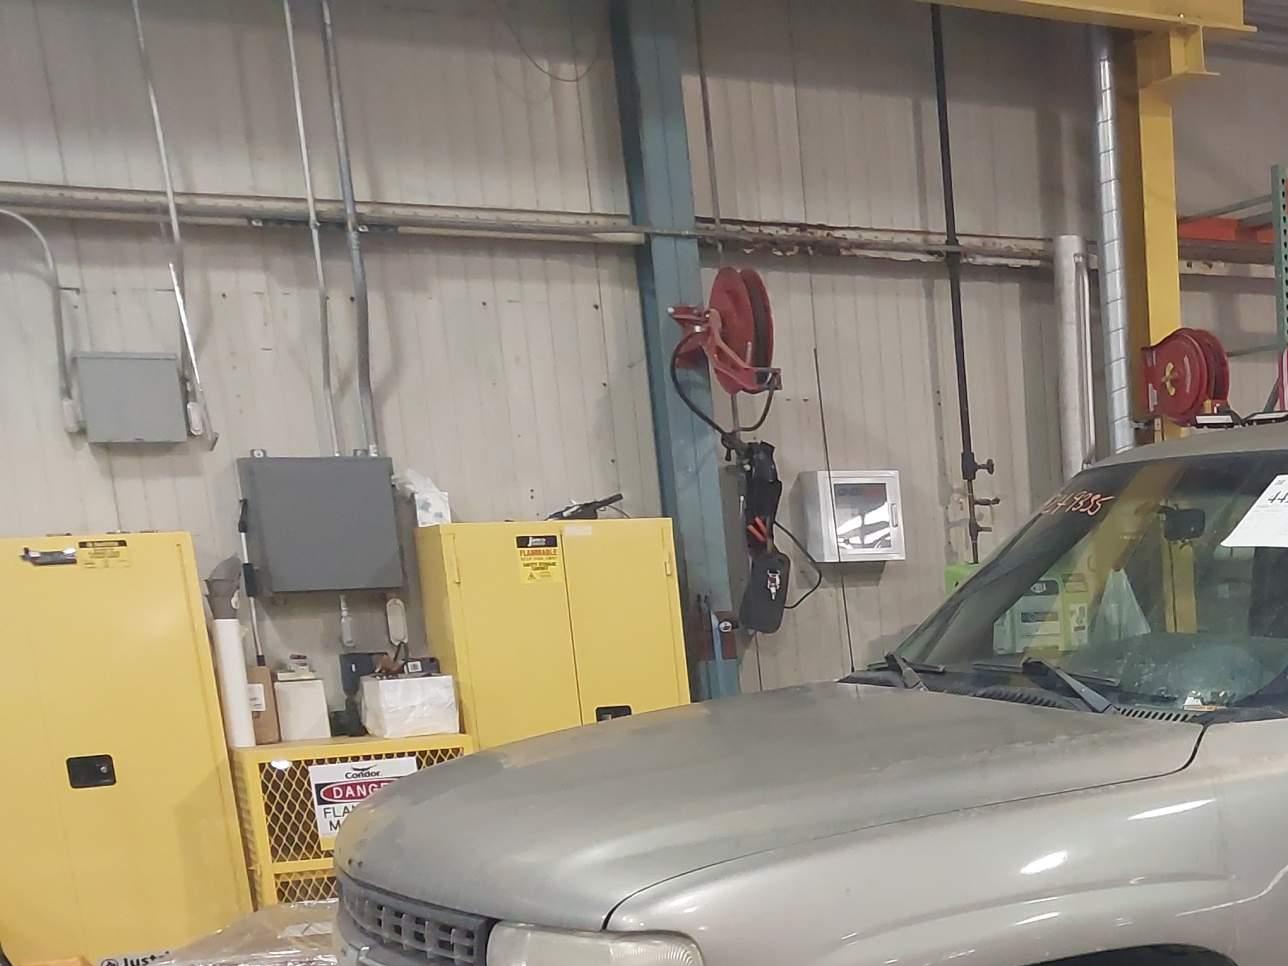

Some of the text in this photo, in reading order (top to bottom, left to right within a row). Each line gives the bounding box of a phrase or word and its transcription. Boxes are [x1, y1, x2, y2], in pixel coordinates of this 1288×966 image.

[344, 770, 381, 780] Condor
[332, 783, 390, 799] DANG
[323, 805, 357, 819] FLA
